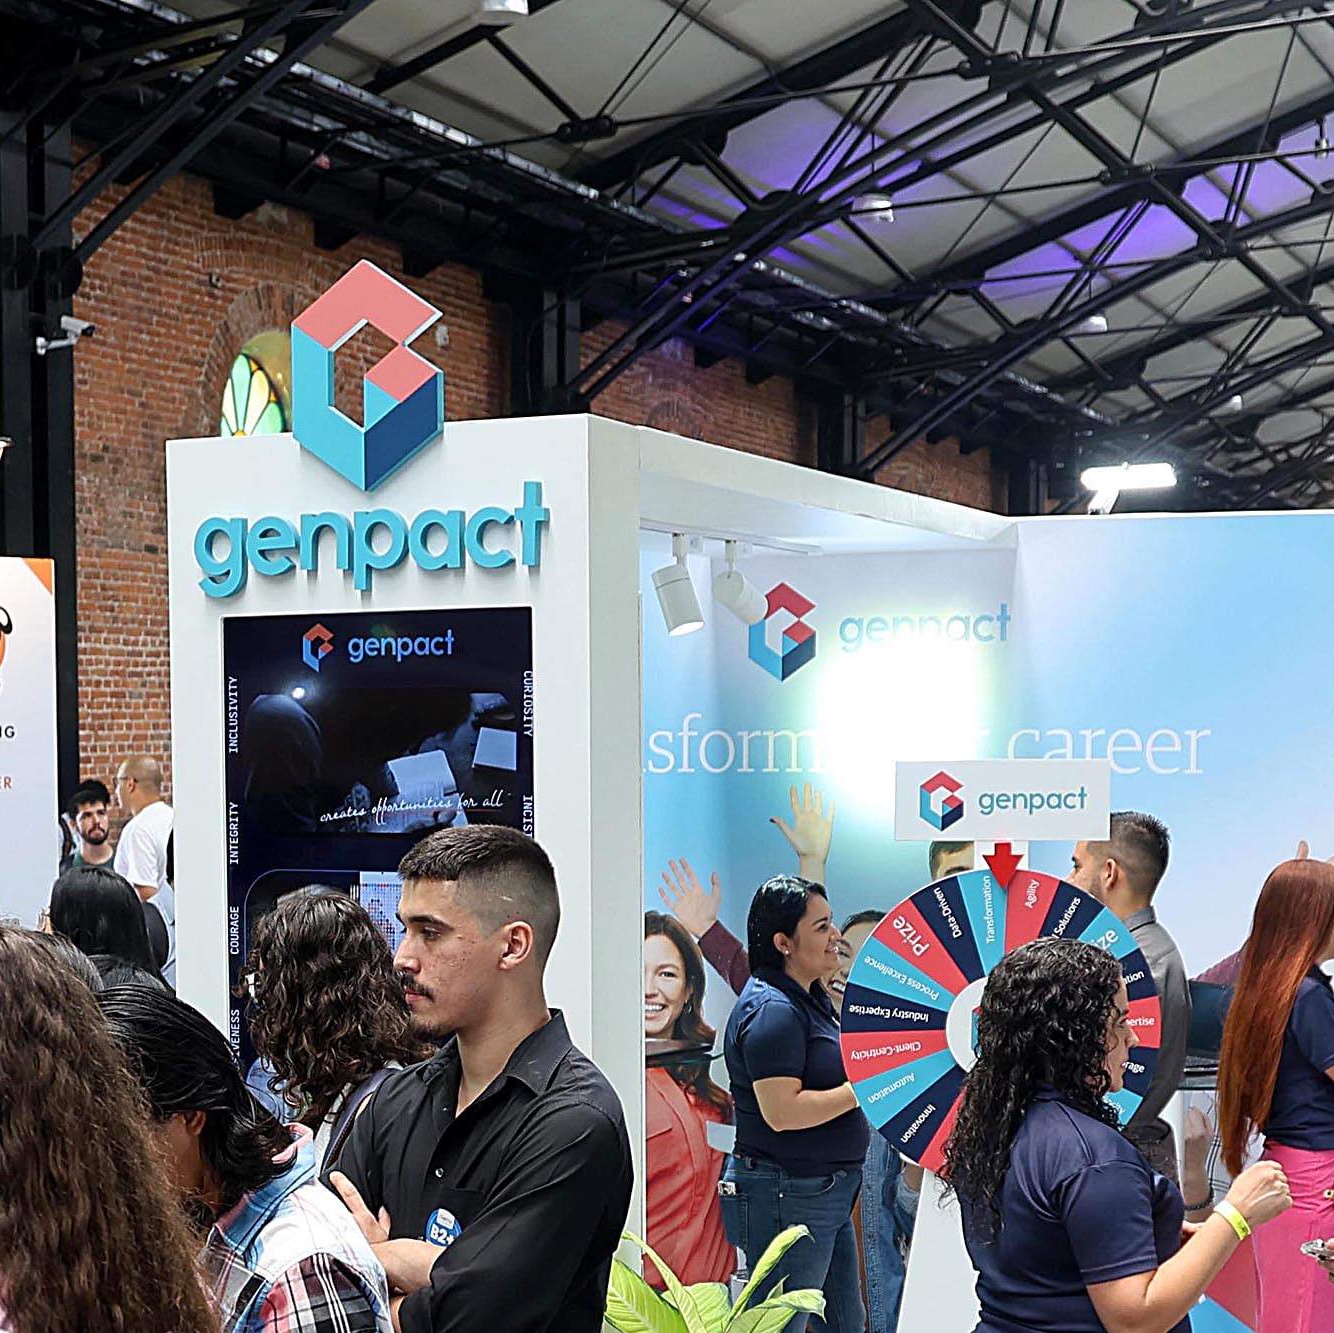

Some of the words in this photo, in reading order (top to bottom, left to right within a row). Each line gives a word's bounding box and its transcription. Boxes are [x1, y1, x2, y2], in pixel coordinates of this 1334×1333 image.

[194, 480, 550, 598] genpact
[348, 629, 455, 663] genpact
[228, 676, 239, 753] INCLUSIVITY
[523, 670, 533, 737] CURIOSITY
[644, 713, 828, 775] sform
[1007, 728, 1212, 774] career
[320, 808, 367, 823] creates
[371, 797, 453, 826] opportunities
[458, 791, 479, 810] for
[482, 789, 504, 808] all
[978, 786, 1088, 815] genpact
[229, 801, 240, 865] INTEGRITY
[933, 887, 963, 938] Data-Driven
[983, 875, 996, 944] Transformation
[1025, 879, 1040, 908] Agility
[230, 905, 240, 955] COURAGE
[892, 915, 930, 957] Prize
[864, 955, 907, 984] Excellence
[906, 978, 939, 1001] Process
[849, 1004, 891, 1018] Expertise
[892, 1007, 929, 1023] Industry
[850, 1040, 921, 1060] Client-Centricity
[868, 1072, 915, 1104] Automation
[900, 1104, 936, 1143] Innovation
